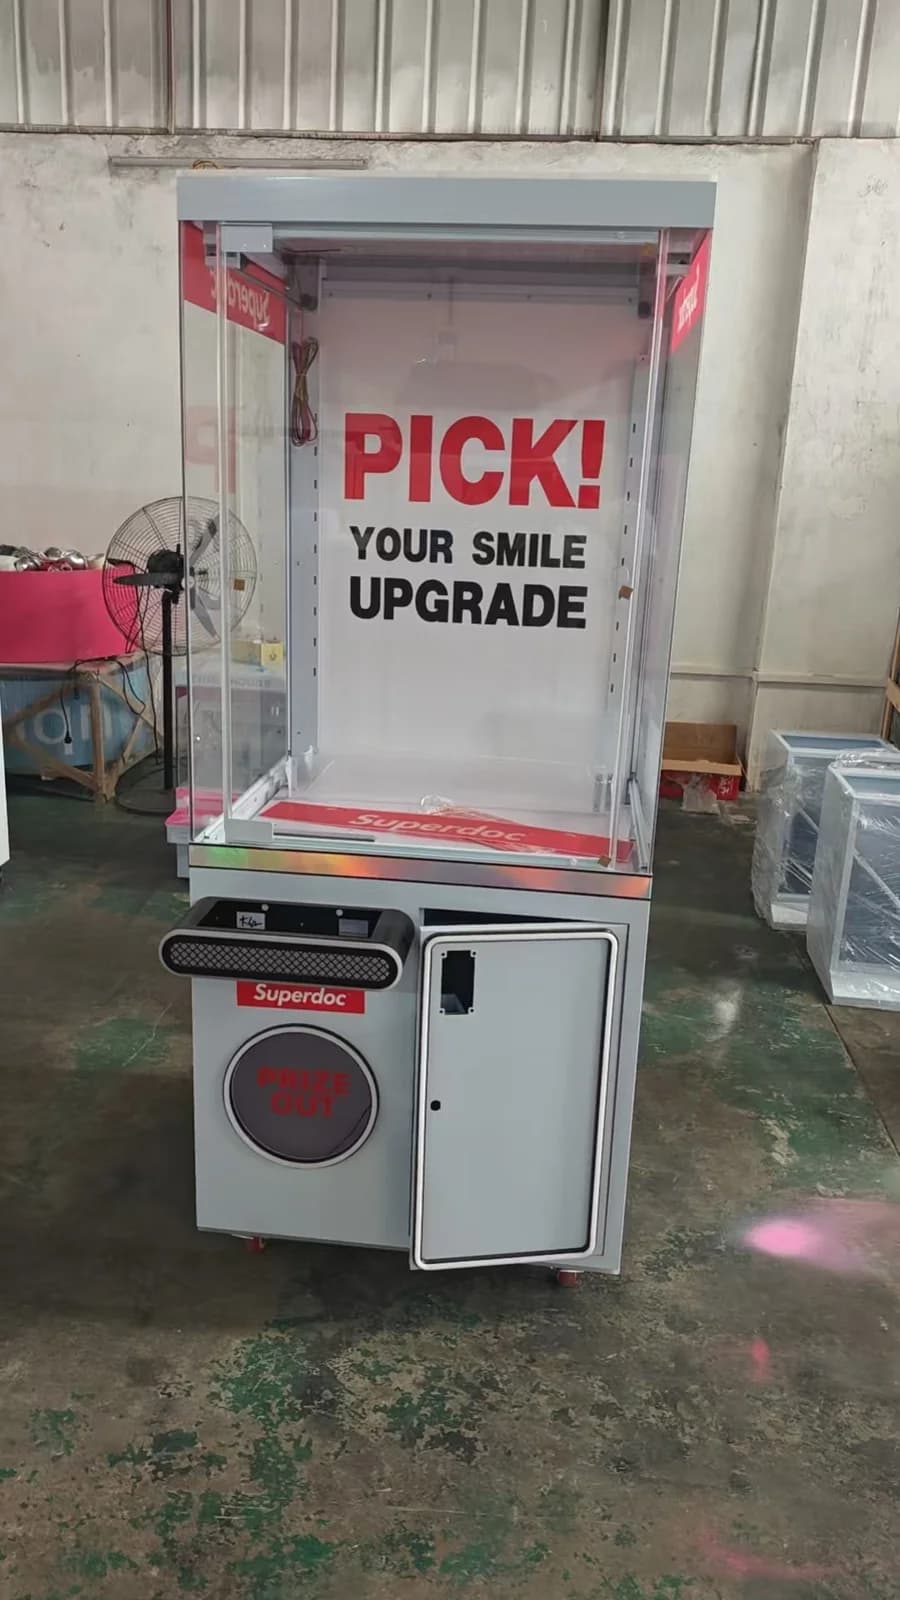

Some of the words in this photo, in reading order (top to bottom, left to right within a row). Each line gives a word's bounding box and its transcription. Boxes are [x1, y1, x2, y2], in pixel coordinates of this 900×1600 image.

[344, 413, 605, 509] PICK!
[349, 526, 453, 564] YOUR
[472, 531, 587, 569] SMILE
[350, 576, 588, 629] UPGRADE
[350, 814, 526, 841] Superdoc
[254, 983, 347, 1006] Superdoc
[256, 1066, 351, 1095] PRIZE
[271, 1093, 336, 1118] OUT
